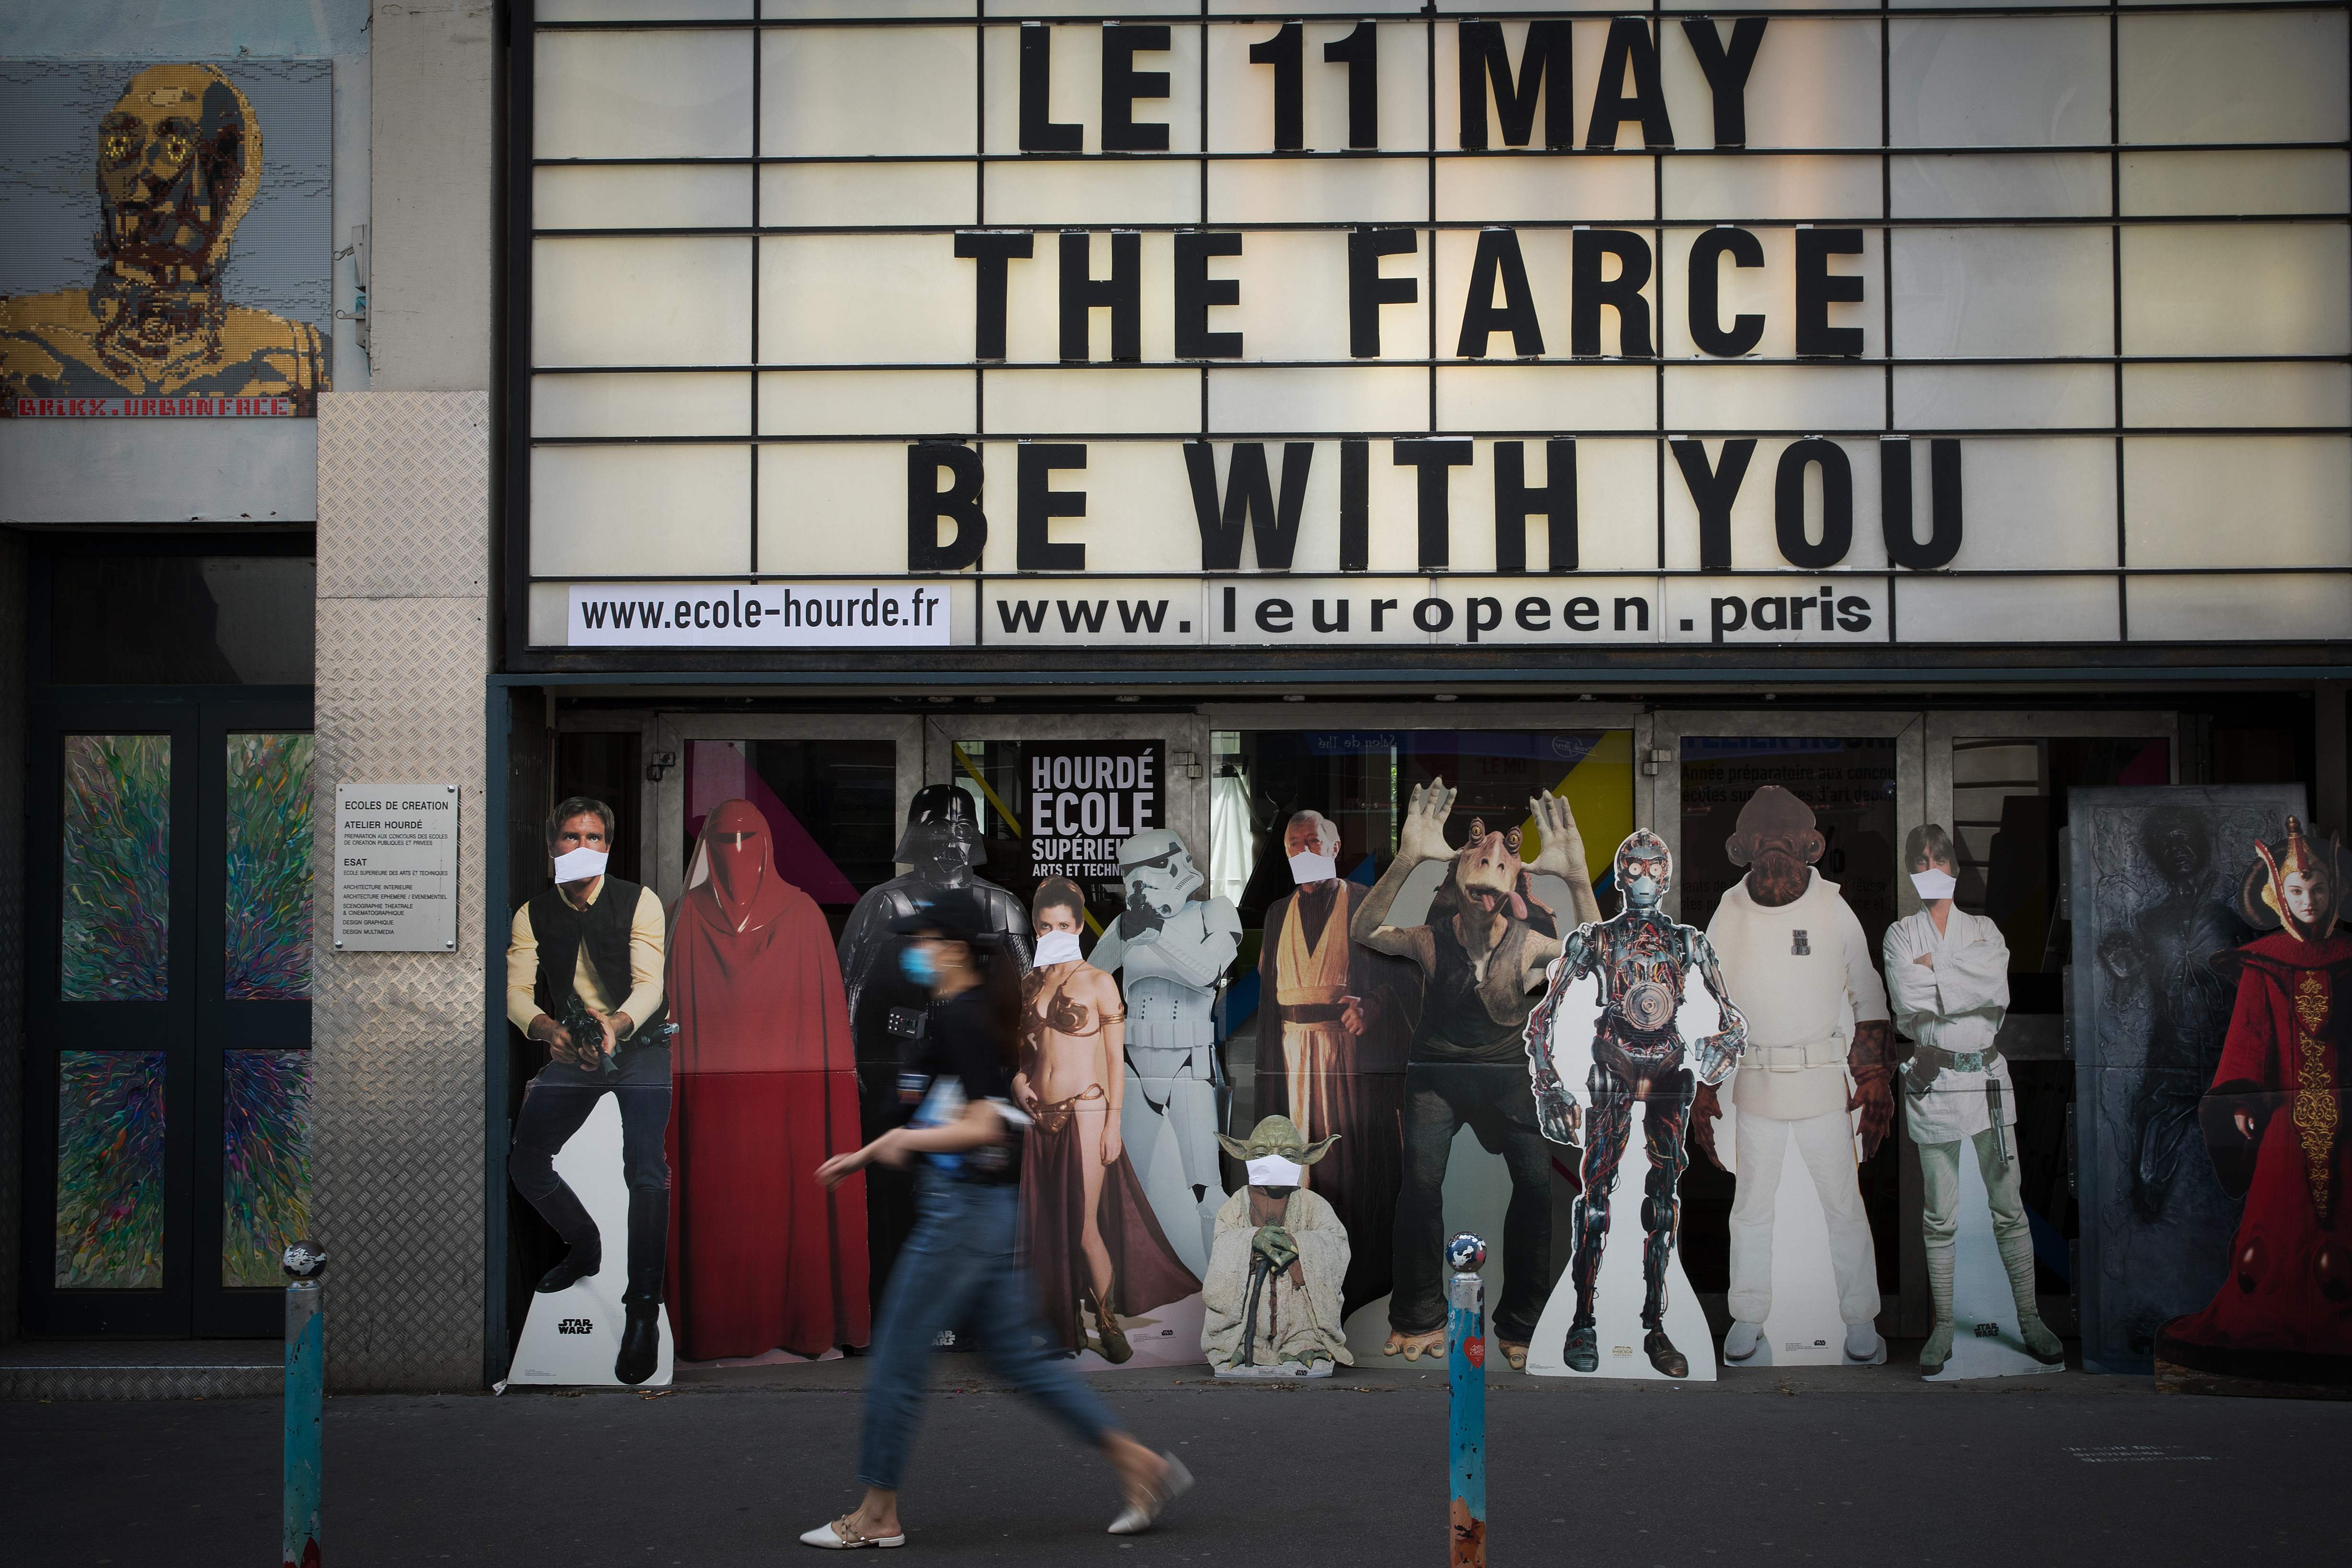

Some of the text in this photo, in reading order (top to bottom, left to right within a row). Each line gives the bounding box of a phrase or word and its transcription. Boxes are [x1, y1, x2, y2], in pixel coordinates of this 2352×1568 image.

[1019, 17, 1768, 151] LE 11 MAY
[954, 228, 1864, 360] THE FARCE
[908, 438, 1963, 571] BE WITH YOU
[581, 587, 941, 630] www.ecole-hourde.fr
[1033, 748, 1154, 789] HOURDÉ
[1818, 767, 1843, 780] aux
[345, 801, 448, 810] ECOLES DE CREATION
[1033, 788, 1154, 835] ÉCOLE
[385, 819, 422, 829] HOURDÉ
[1033, 864, 1062, 876] ARTS
[1067, 864, 1080, 876] ET
[1974, 1323, 1999, 1331] STAR
[1974, 1329, 2000, 1338] WARS
